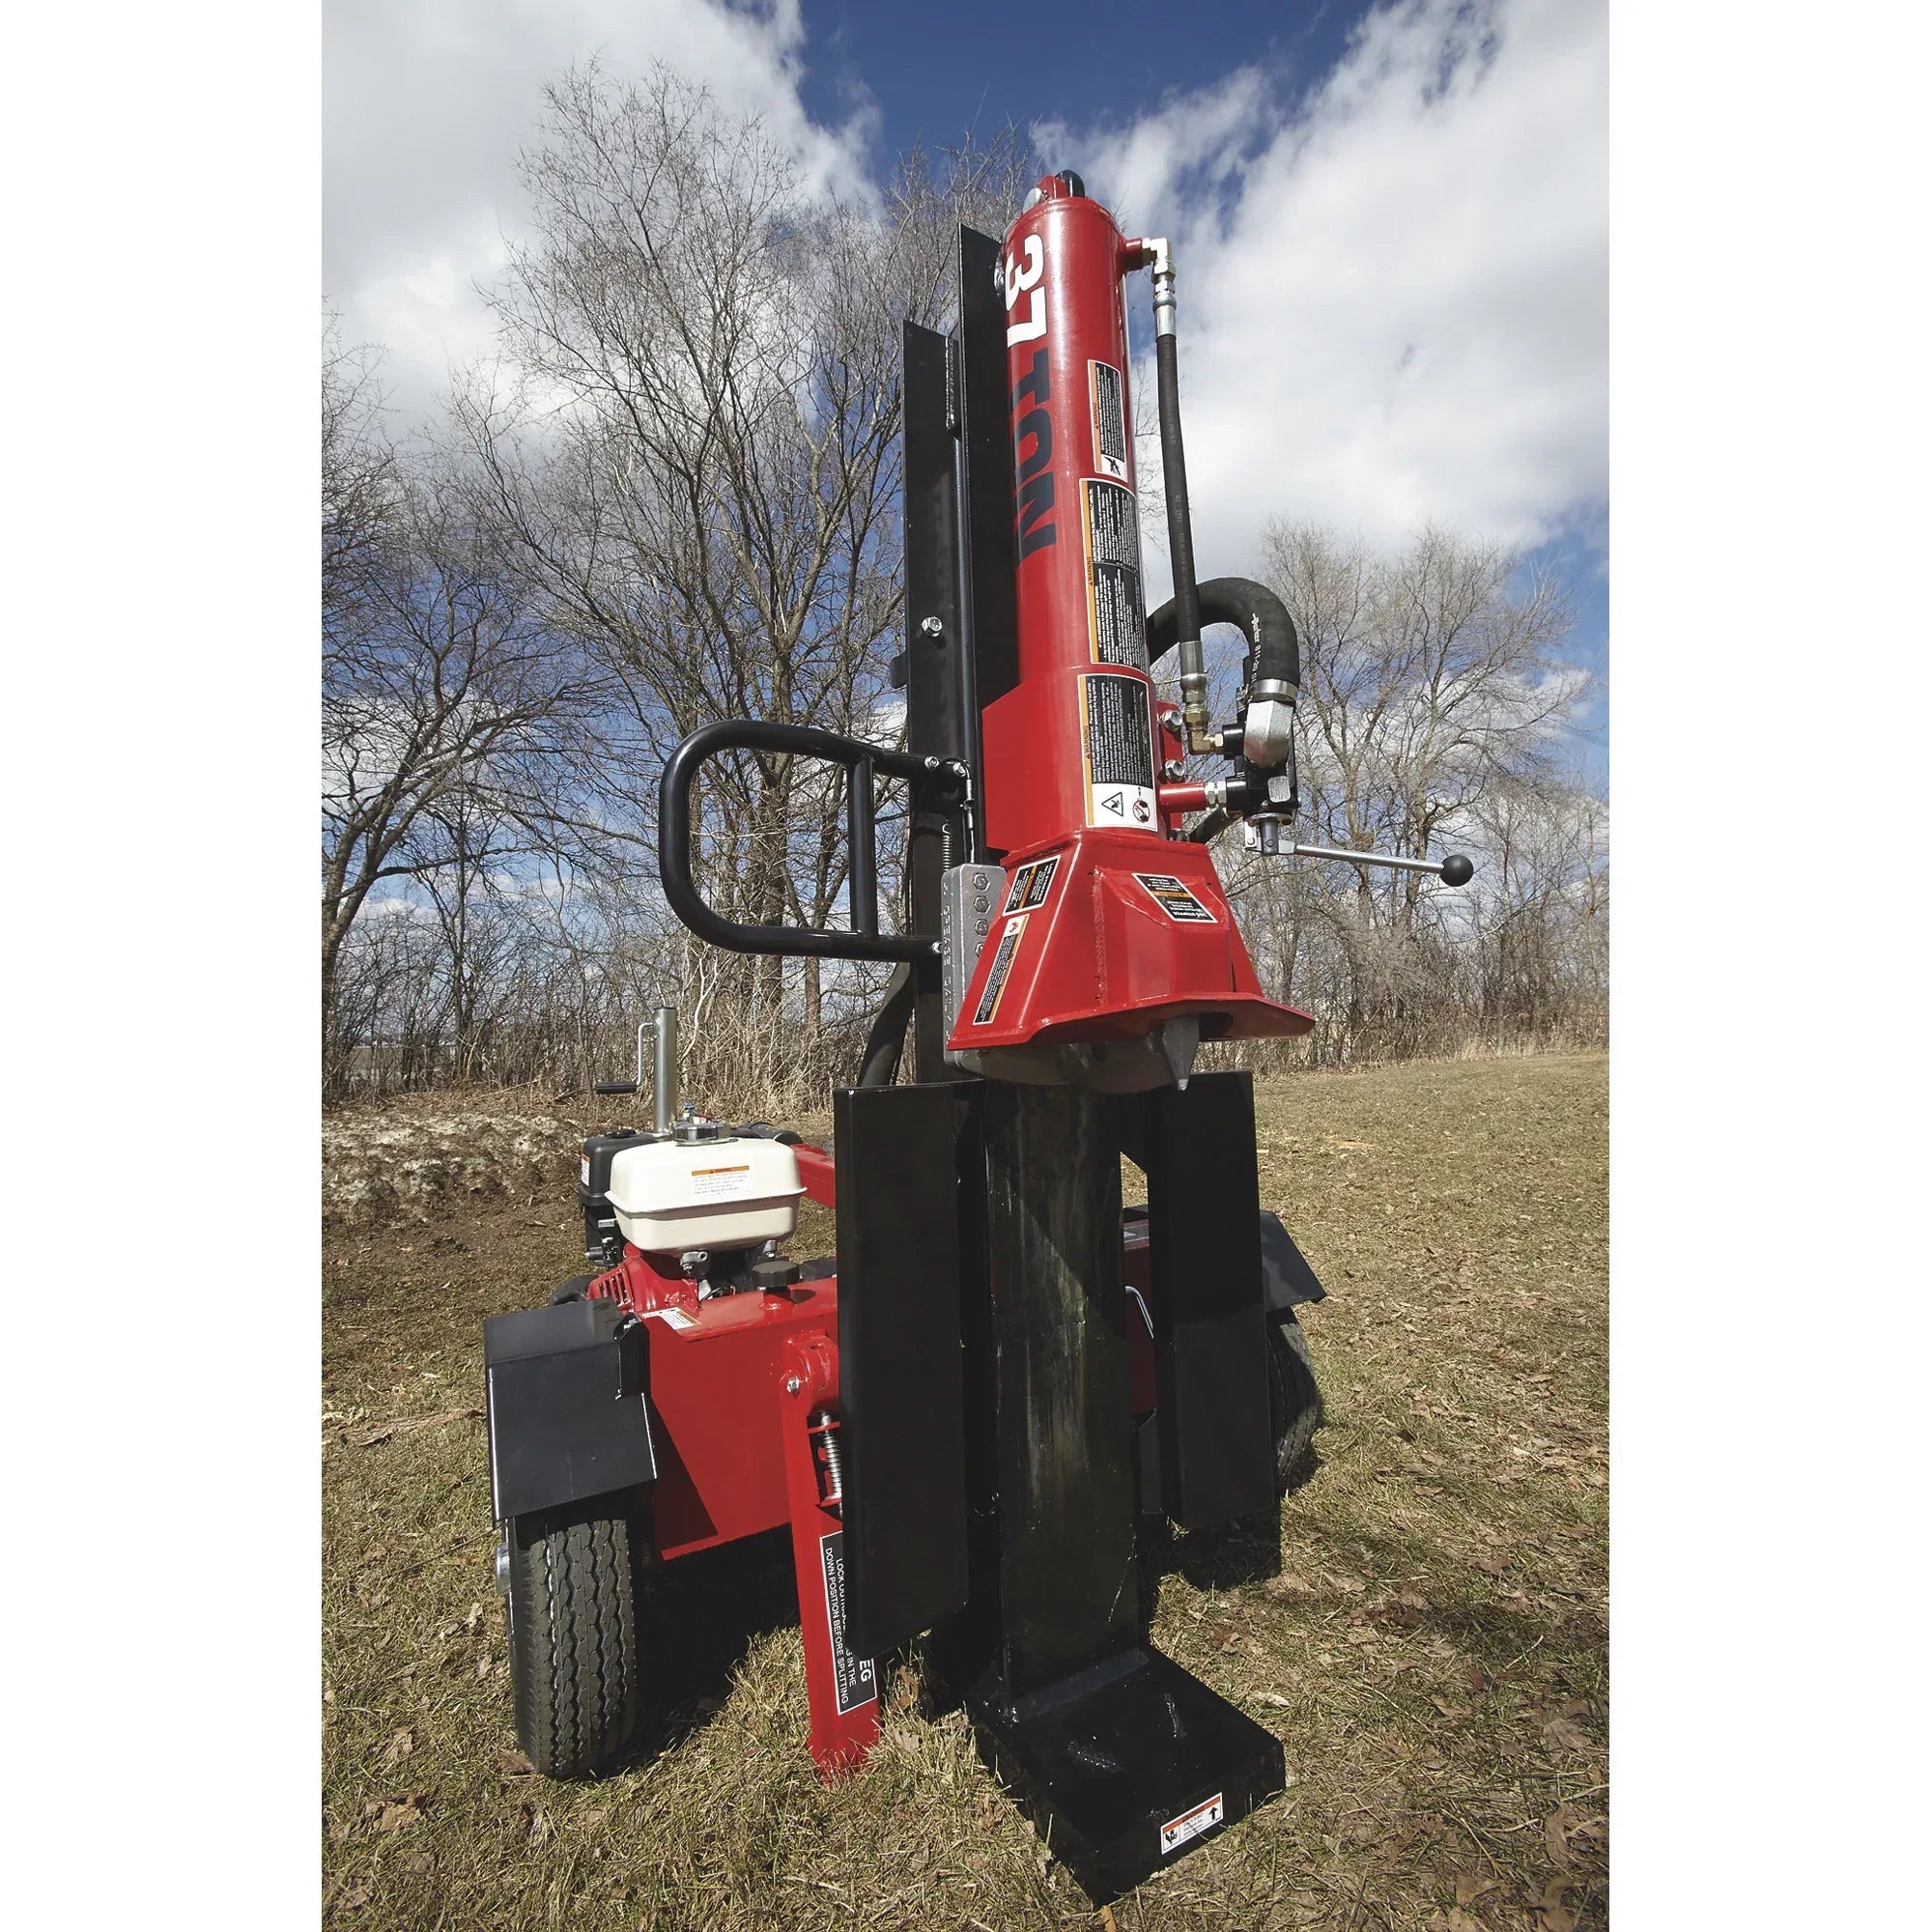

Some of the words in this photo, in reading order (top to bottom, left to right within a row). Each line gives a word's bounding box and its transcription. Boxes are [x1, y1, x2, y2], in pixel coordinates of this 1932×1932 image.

[1005, 233, 1048, 348] 37
[1012, 349, 1058, 563] TON
[825, 1547, 835, 1576] DOWN
[836, 1557, 845, 1582] LOCK
[828, 1577, 839, 1619] POSITION
[833, 1619, 843, 1657] BEFORE
[837, 1656, 849, 1704] SPLITTING
[846, 1656, 854, 1667] IN
[847, 1666, 856, 1687] THE
